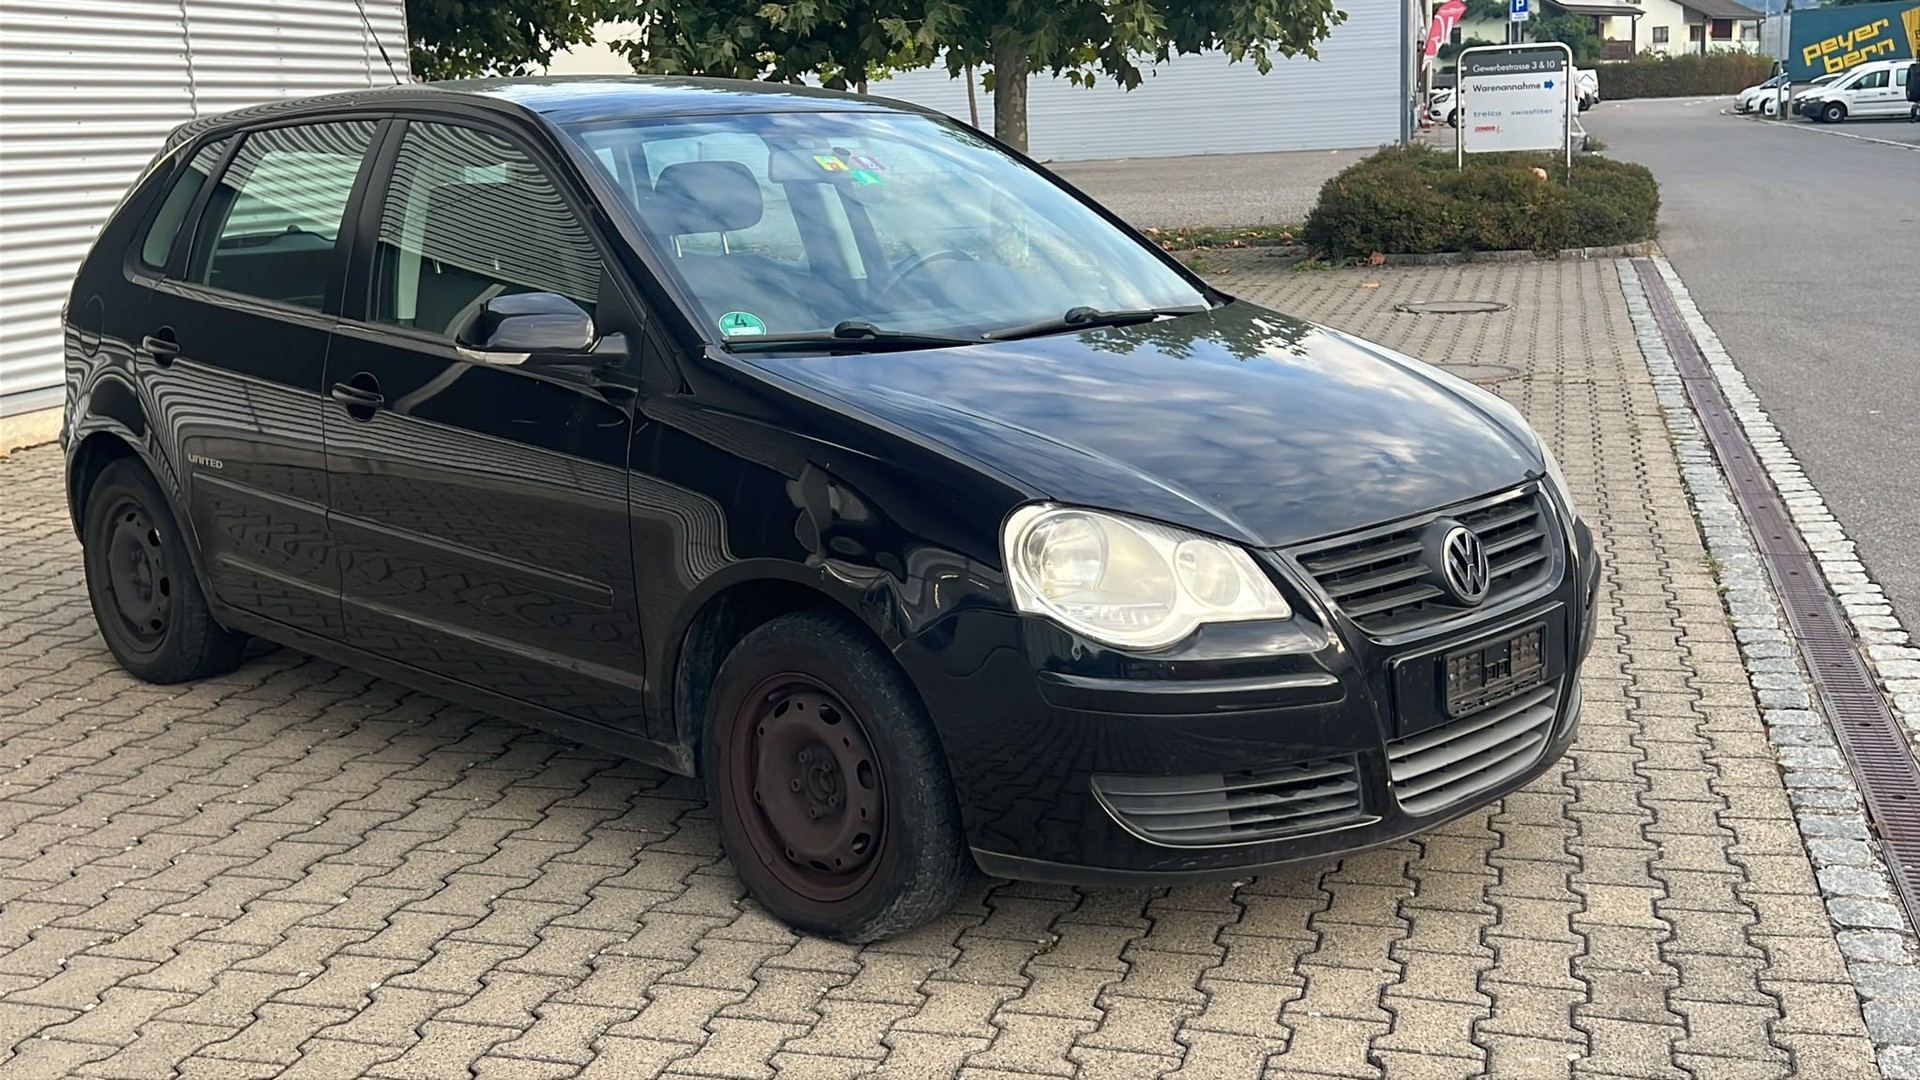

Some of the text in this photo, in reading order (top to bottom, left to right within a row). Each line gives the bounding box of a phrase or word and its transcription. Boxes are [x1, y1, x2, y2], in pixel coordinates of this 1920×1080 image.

[1516, 0, 1524, 11] P
[1802, 18, 1889, 67] peyer
[1823, 38, 1895, 74] bern
[1472, 60, 1555, 73] Gewerbestrasse 3 & 10
[1472, 82, 1541, 92] Warenannahme
[734, 314, 748, 327] 4
[188, 453, 223, 469] UNITED
